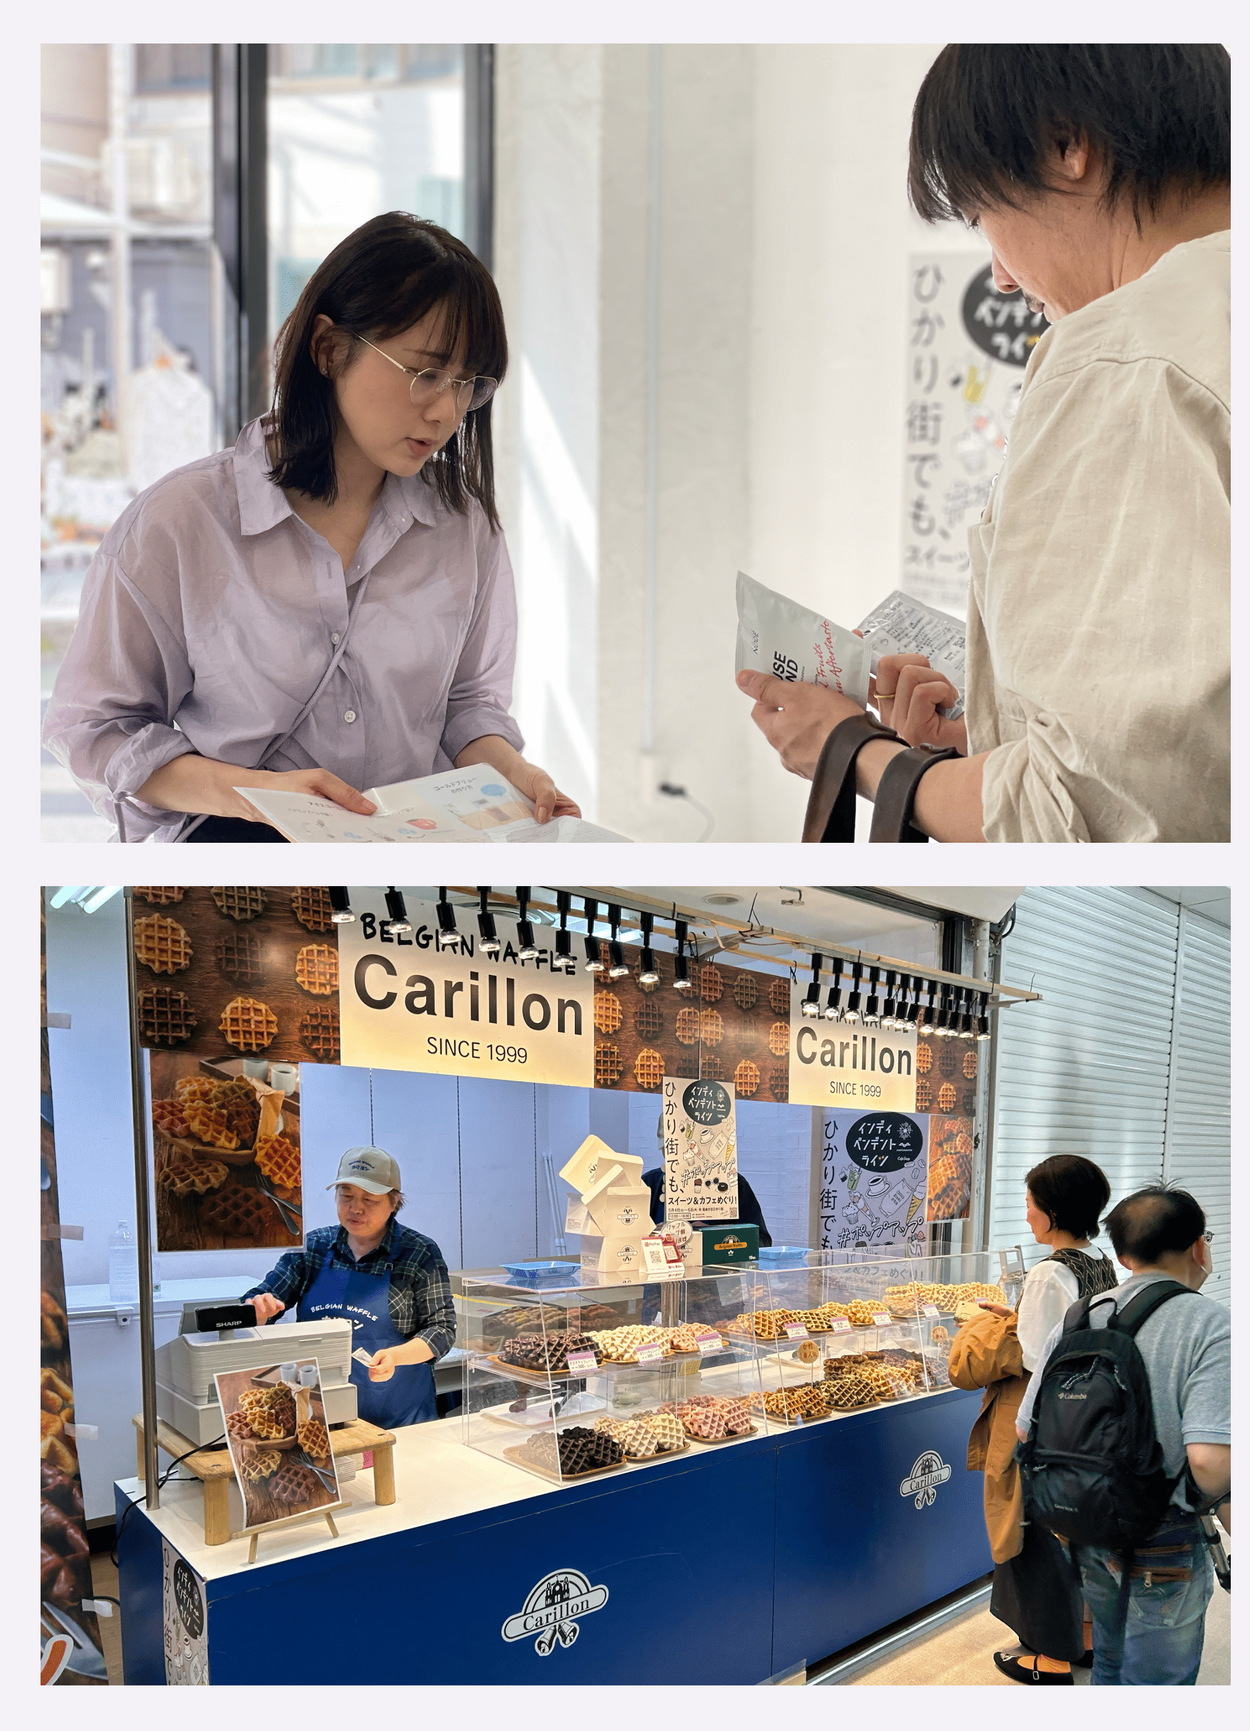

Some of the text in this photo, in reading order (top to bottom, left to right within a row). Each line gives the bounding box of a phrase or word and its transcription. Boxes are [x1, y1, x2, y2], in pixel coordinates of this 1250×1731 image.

[353, 954, 583, 1036] Carillon
[427, 1036, 528, 1065] SINCE 1999
[796, 1026, 912, 1076] Carillon
[829, 1081, 882, 1098] SINCE 1999
[665, 1081, 685, 1193] ひかり街でも、
[859, 1120, 892, 1135] インディ
[853, 1137, 896, 1151] ペンデント
[310, 1303, 378, 1321] BELGIAN WAFFLE
[215, 1320, 243, 1328] SHARP
[909, 1473, 943, 1492] Carillon
[523, 1599, 591, 1633] Carillon
